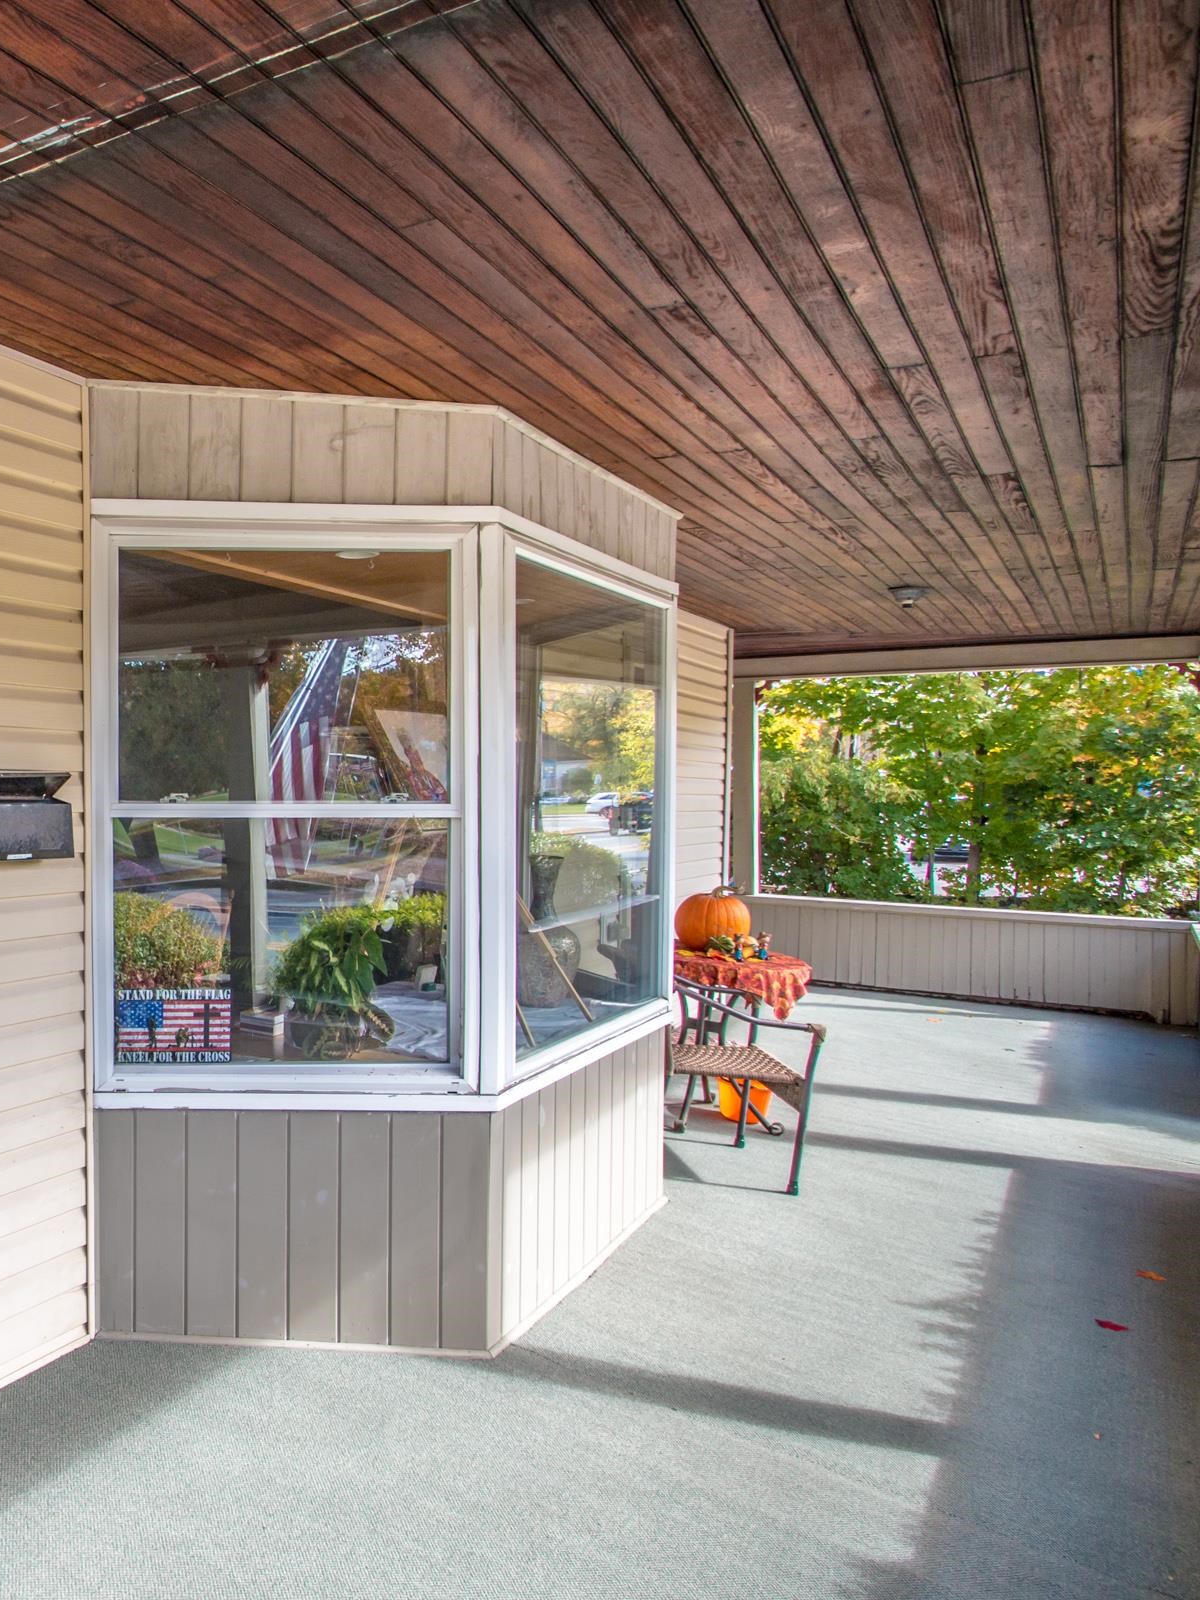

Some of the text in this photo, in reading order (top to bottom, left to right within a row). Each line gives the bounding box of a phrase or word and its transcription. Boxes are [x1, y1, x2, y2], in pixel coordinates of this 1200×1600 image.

[118, 989, 231, 1000] STAND FOR THE FLAG
[118, 1051, 230, 1063] KNEEL FOR THE CROSS
